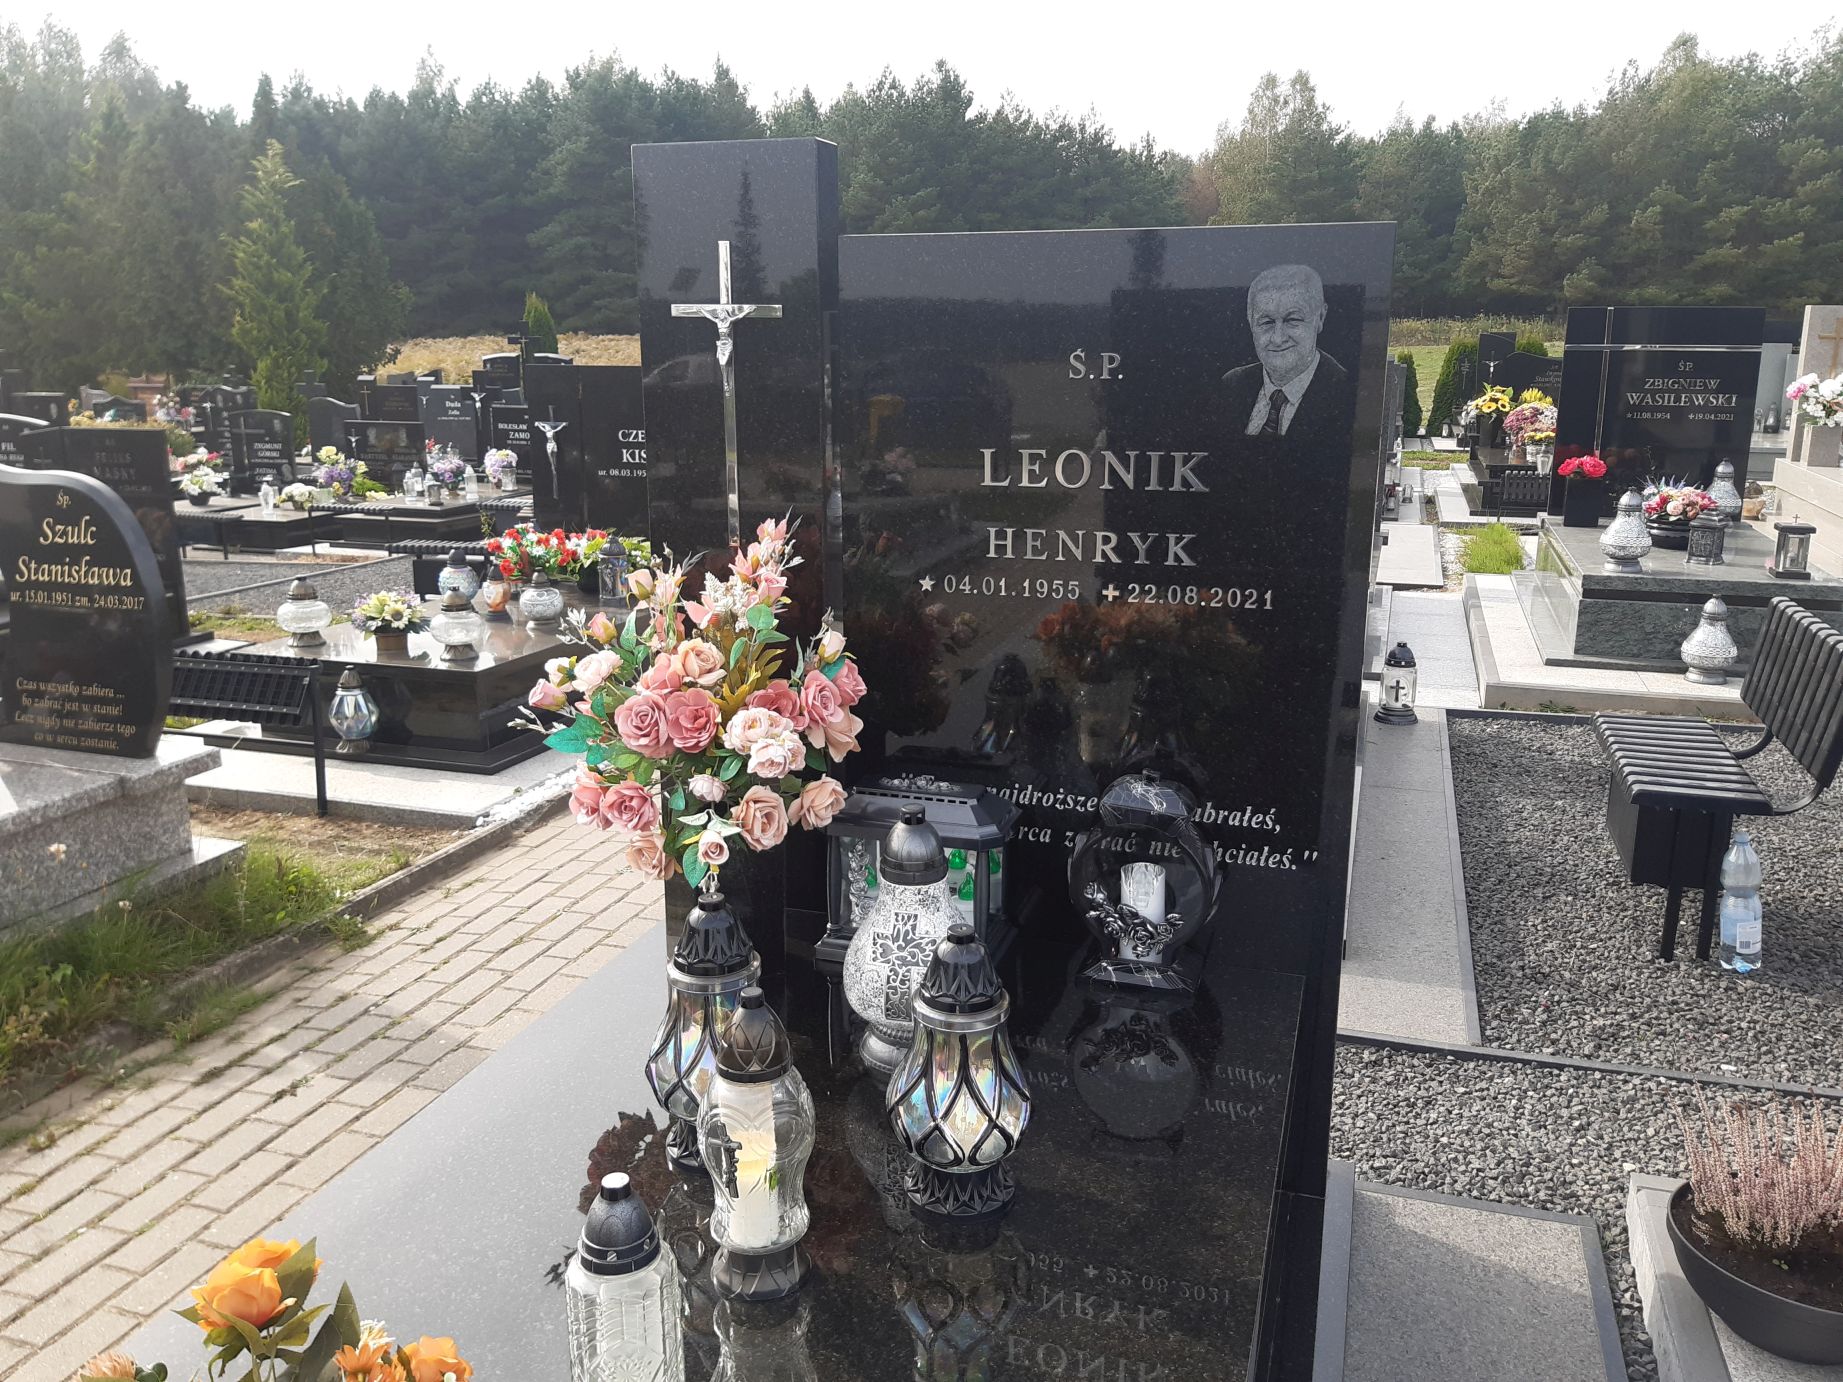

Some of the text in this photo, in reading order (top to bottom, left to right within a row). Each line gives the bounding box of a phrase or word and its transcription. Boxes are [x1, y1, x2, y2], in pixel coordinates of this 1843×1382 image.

[1069, 348, 1124, 380] Ś.P.
[1643, 378, 1721, 390] ZBIGNIEW
[1625, 392, 1738, 407] WASILEWSKI
[509, 431, 530, 439] ZAMO
[618, 429, 646, 442] CZE
[621, 449, 647, 464] KIS
[609, 468, 647, 477] 08.03.195
[980, 448, 1210, 493] LEONIK
[39, 515, 97, 545] Szulc
[985, 527, 1198, 567] HENRYK
[15, 555, 134, 587] Stanisława
[25, 590, 72, 605] 15.01.1951
[75, 596, 91, 608] zm.
[94, 594, 145, 610] 24.03.2017
[943, 574, 1273, 609] 04.01.1955 22.08.2021
[16, 676, 37, 690] Czas
[38, 680, 80, 697] wszystko
[82, 683, 114, 697] zabiera
[22, 693, 32, 706] bo
[63, 700, 79, 712] jest
[92, 703, 123, 716] stanie!
[15, 710, 35, 724] Lecz
[36, 712, 60, 730] nigdy
[78, 717, 116, 732] zabierze
[117, 723, 136, 737] tego
[1191, 801, 1280, 834] abrałeś,
[1009, 826, 1051, 845] rca
[1213, 840, 1318, 870] hciałeś."
